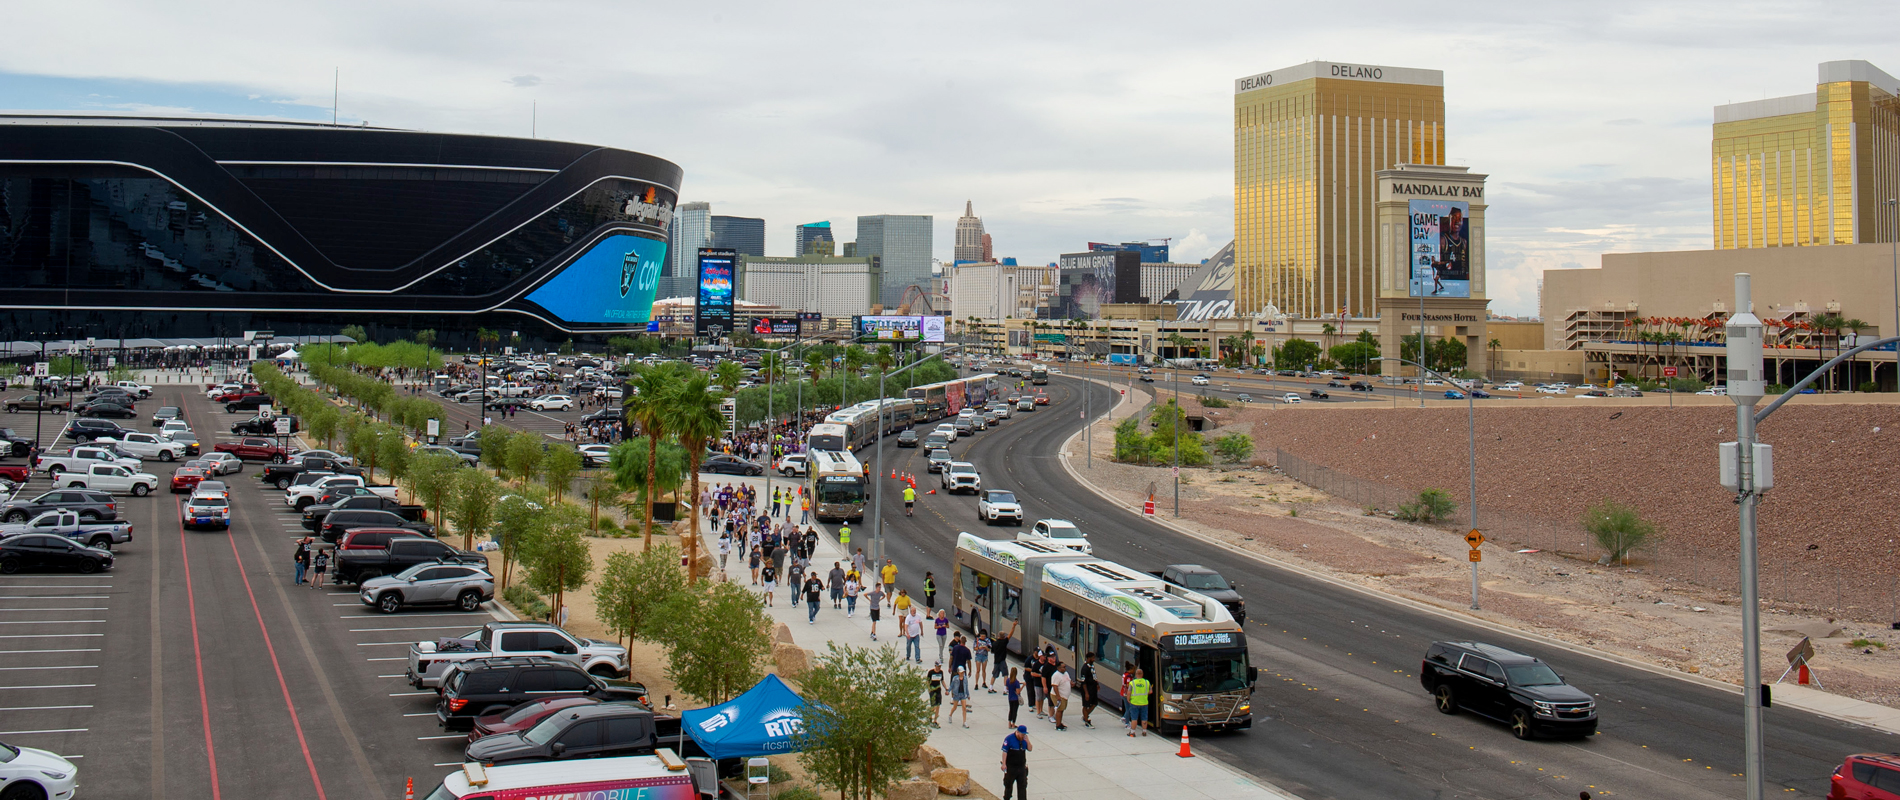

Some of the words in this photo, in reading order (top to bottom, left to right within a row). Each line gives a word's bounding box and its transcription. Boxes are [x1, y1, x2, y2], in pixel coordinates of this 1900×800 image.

[1331, 65, 1383, 80] DELANO
[1241, 74, 1273, 91] DELANO
[1392, 183, 1460, 197] MANDALAY
[1462, 186, 1484, 198] BAY
[625, 195, 660, 223] allegiant
[1413, 213, 1439, 226] GAME
[1413, 227, 1430, 240] DAY
[1061, 257, 1077, 270] BLUE
[1077, 256, 1092, 269] MAN
[1092, 254, 1115, 268] GROUP
[1450, 251, 1456, 262] 4
[639, 260, 660, 291] COX
[1160, 300, 1235, 321] TMGM
[1401, 312, 1421, 321] FOUR
[1423, 313, 1453, 321] SEASONS
[1453, 313, 1478, 322] HOTEL
[986, 546, 1008, 565] Natural
[1008, 555, 1020, 570] Gas
[811, 584, 820, 593] 16
[1082, 586, 1102, 602] GREENER
[1174, 635, 1188, 646] 610
[1172, 670, 1183, 684] 14
[699, 713, 729, 733] RTC
[764, 718, 807, 738] RTC
